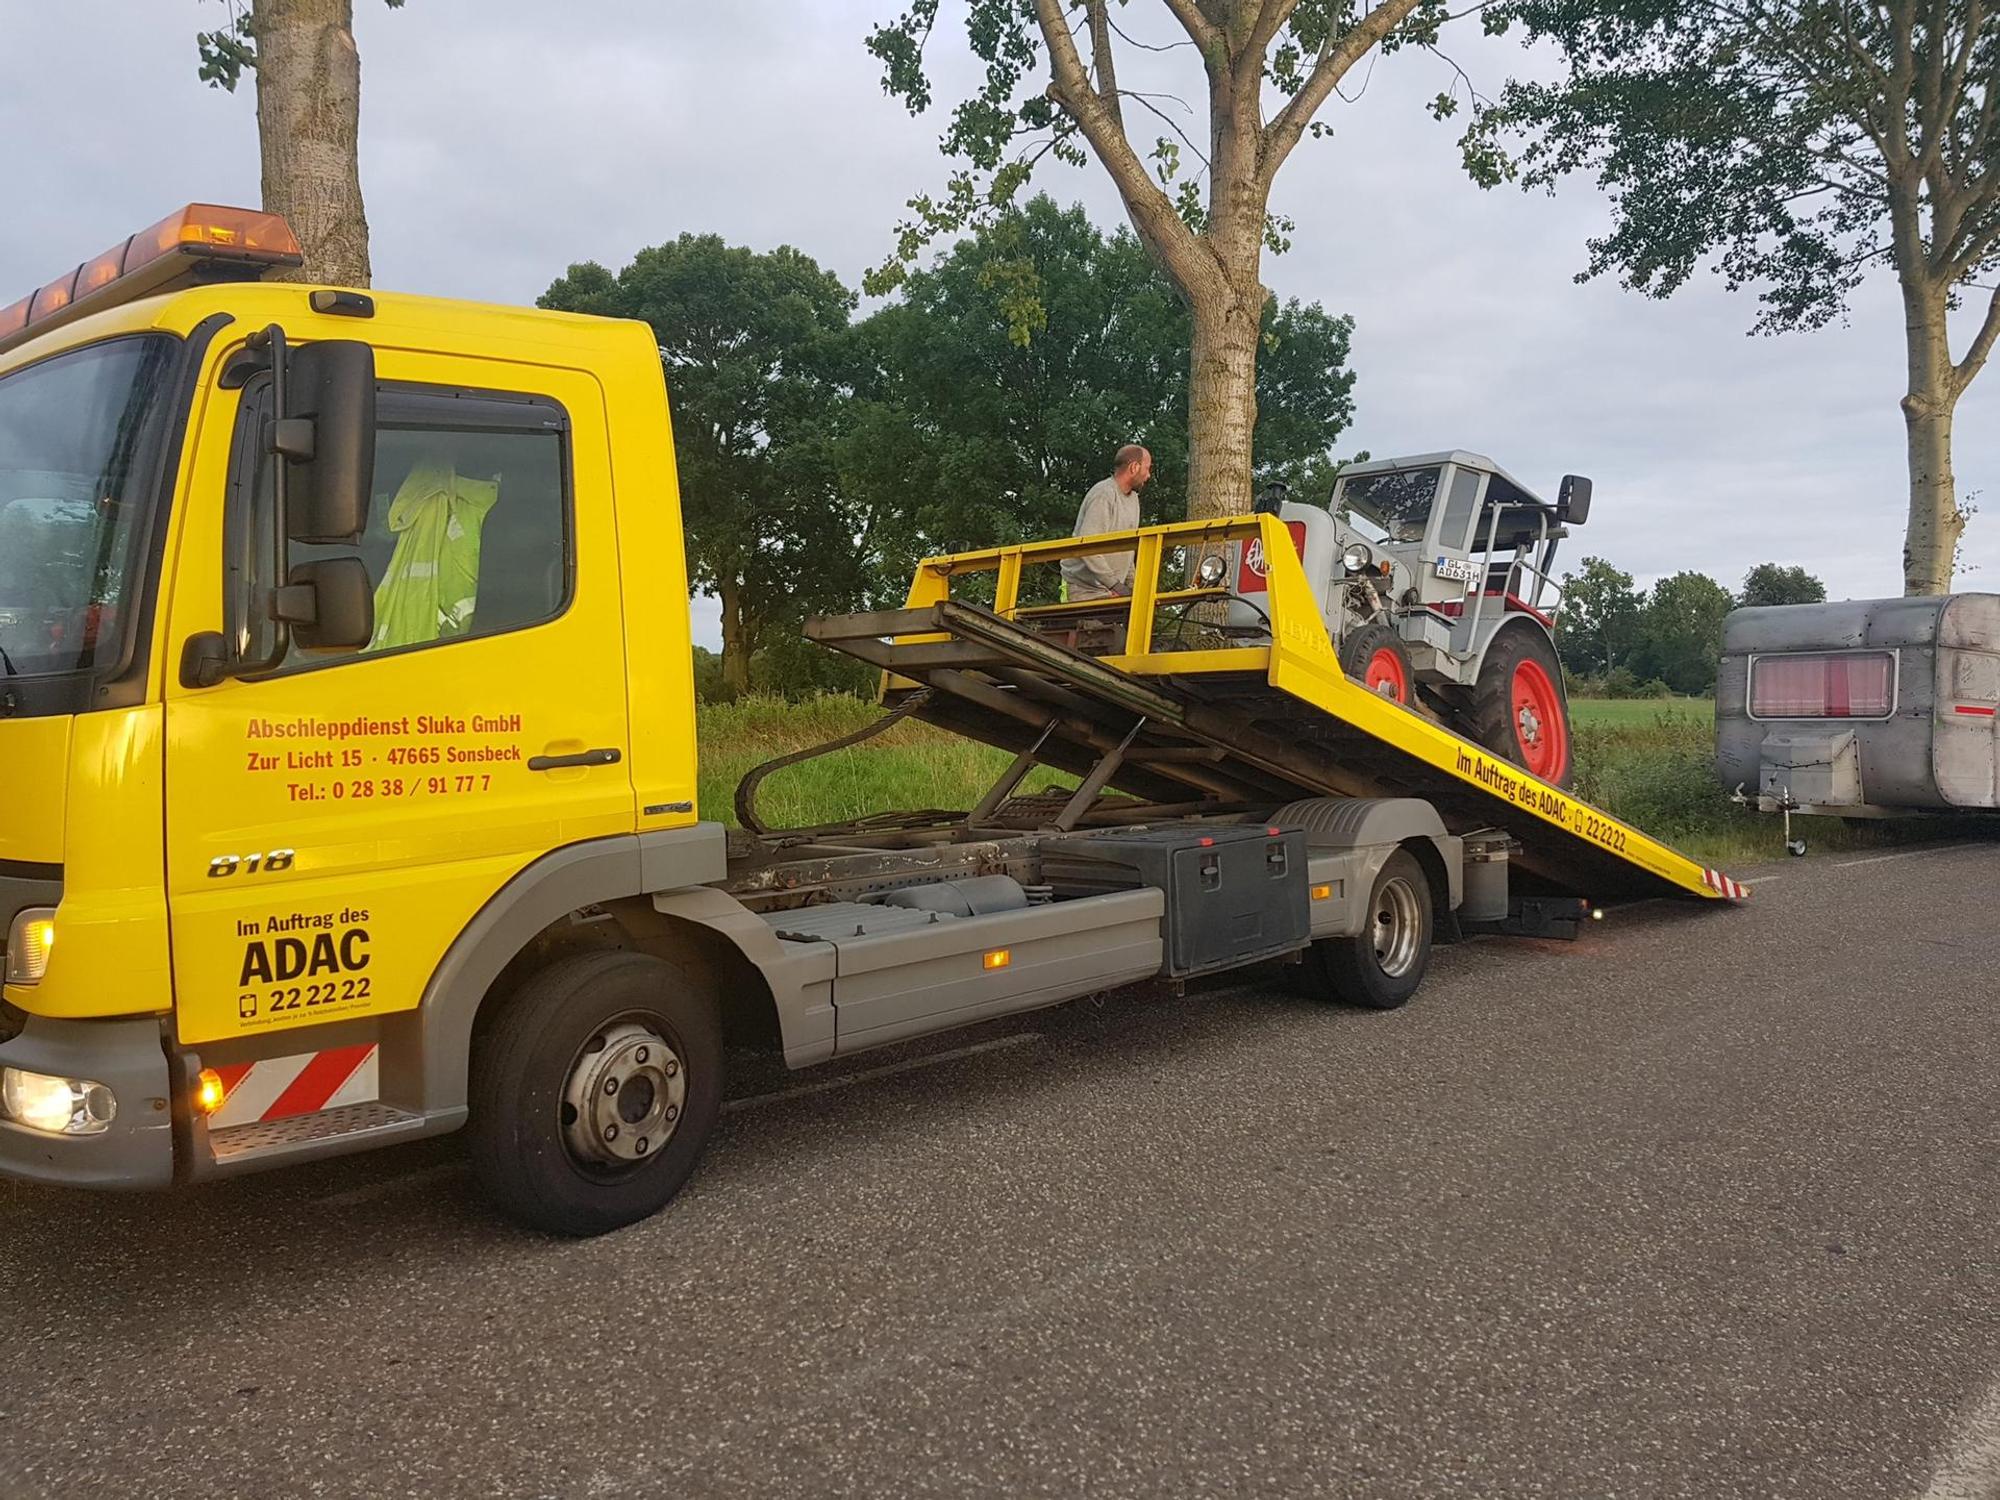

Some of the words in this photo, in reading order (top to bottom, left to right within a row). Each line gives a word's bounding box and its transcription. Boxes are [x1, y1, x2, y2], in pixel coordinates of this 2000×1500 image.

[1447, 559, 1461, 569] GL
[247, 717, 409, 740] Abschleppdienst
[417, 715, 466, 735] Sluka
[472, 714, 521, 733] GmbH
[247, 752, 280, 771] Zur
[287, 751, 334, 769] Licht
[341, 749, 363, 767] 15
[387, 747, 440, 765] 47665
[447, 744, 521, 763] Sonsbeck
[287, 783, 326, 801] Tel.:
[332, 781, 345, 799] 0
[351, 780, 375, 798] 28
[381, 779, 404, 797] 38
[428, 776, 448, 794] 91
[454, 775, 475, 793] 77
[481, 774, 491, 791] 7
[1456, 746, 1471, 775] Im
[1474, 757, 1517, 802] Auftrag
[1518, 780, 1537, 809] des
[207, 848, 295, 878] 818
[236, 920, 260, 937] Im
[266, 912, 335, 934] Auftrag
[339, 907, 370, 924] des
[239, 928, 371, 988] ADAC
